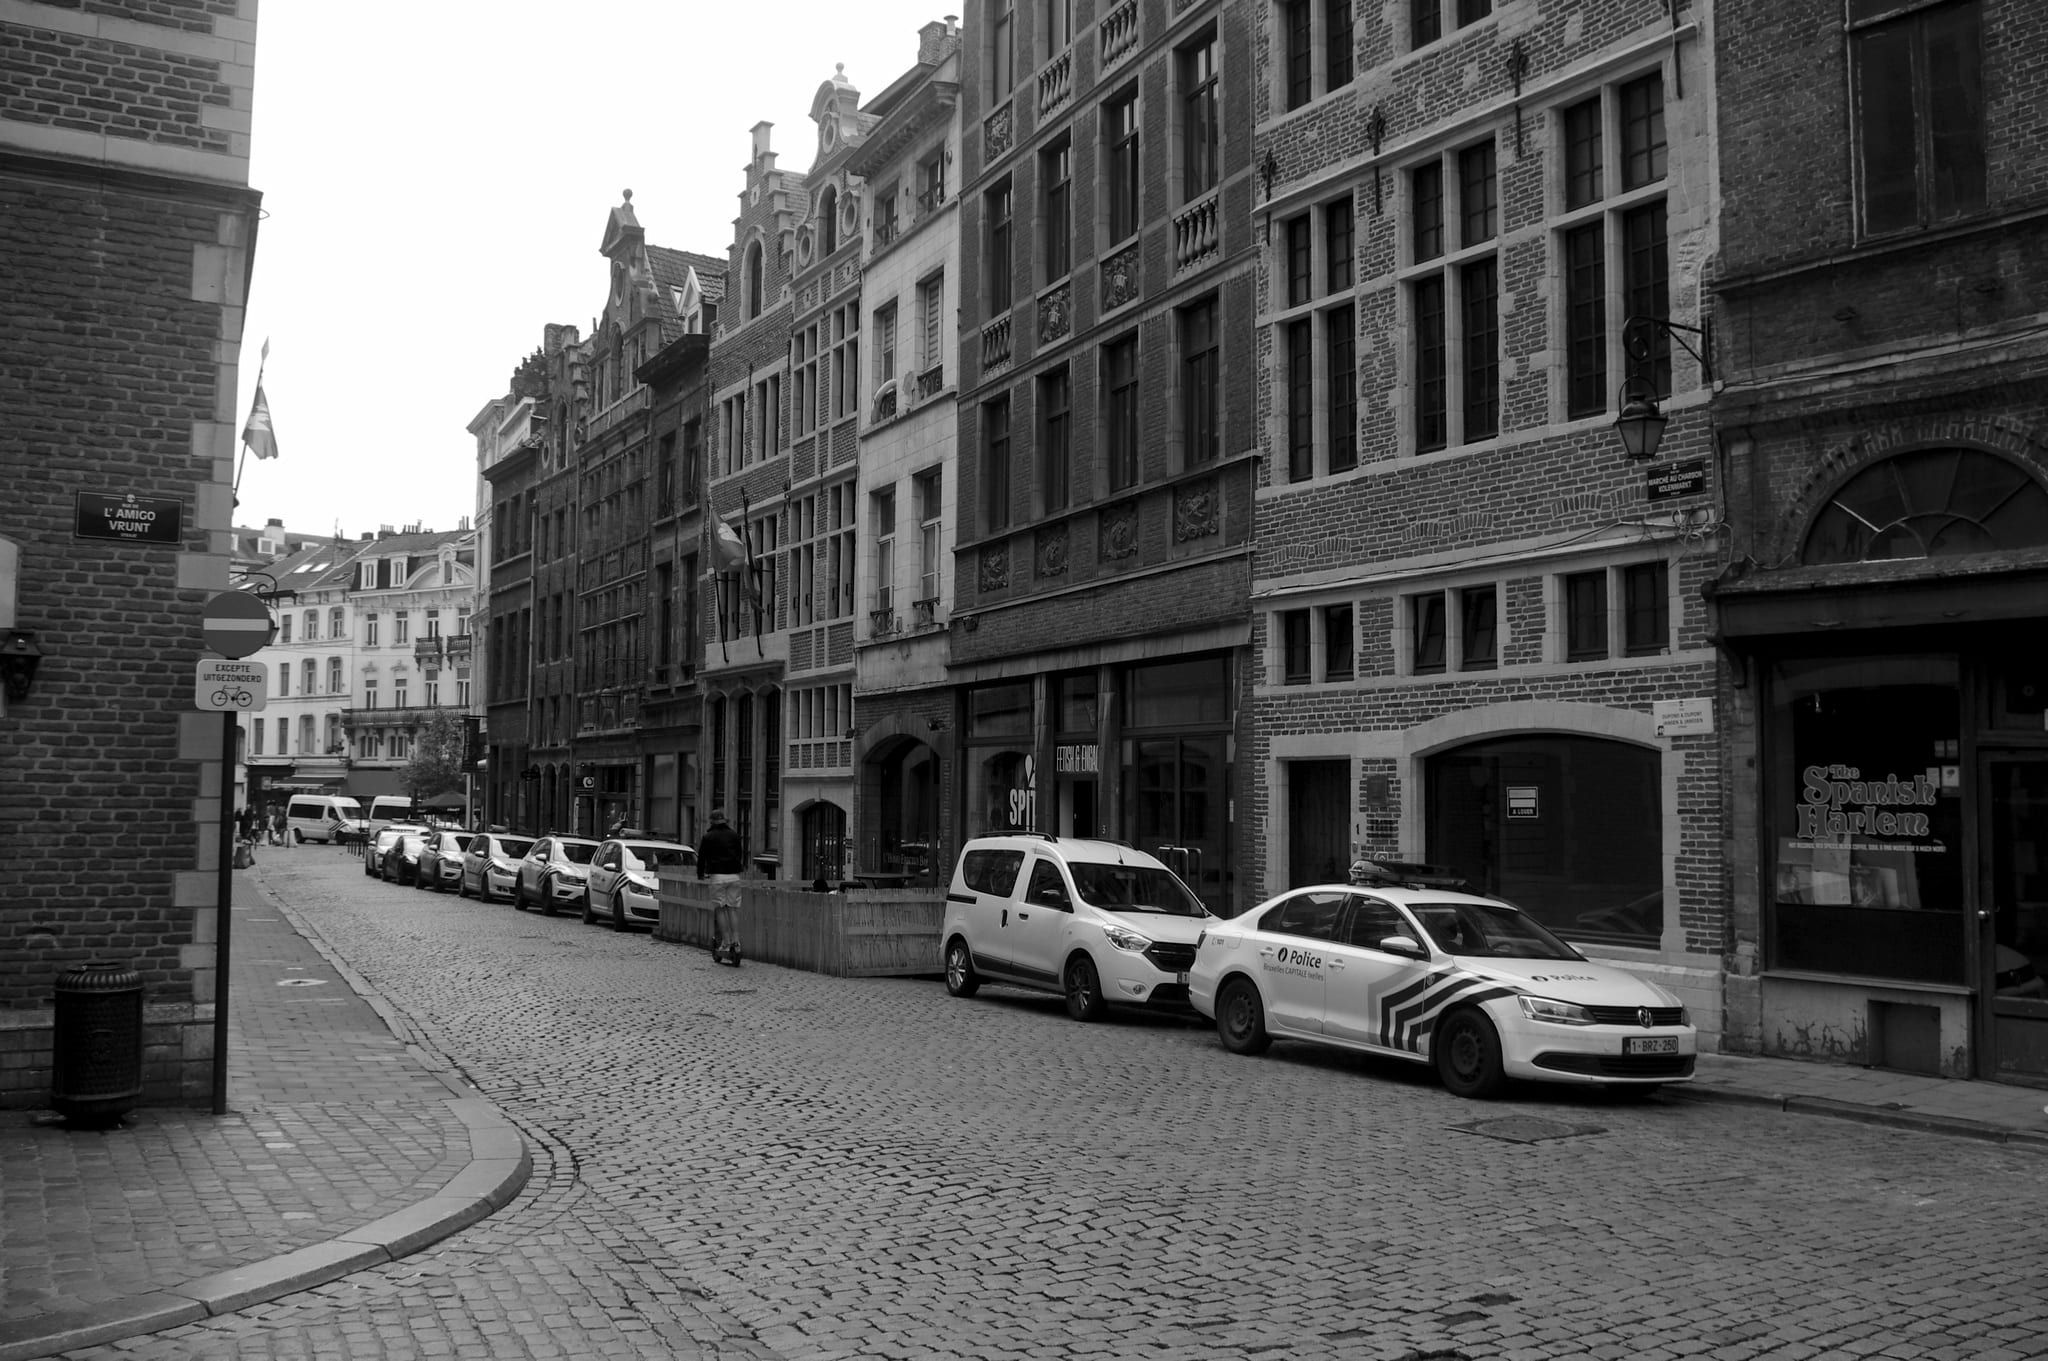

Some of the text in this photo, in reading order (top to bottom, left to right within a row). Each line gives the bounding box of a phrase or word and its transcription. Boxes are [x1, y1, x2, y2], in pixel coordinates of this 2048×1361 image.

[1649, 475, 1669, 486] MARCHÉ
[1670, 474, 1677, 482] AU
[116, 508, 156, 521] AMIGO
[109, 520, 151, 533] VRUNT
[216, 664, 250, 673] EXCEPTE
[203, 673, 262, 683] UITGEZONDERD
[1829, 764, 1860, 779] The
[1803, 765, 1937, 811] Spanish
[1796, 803, 1930, 840] Harlem
[1290, 950, 1322, 970] Police
[1263, 963, 1285, 974] Bruxelles
[1285, 967, 1307, 979] CAPITALE
[1632, 1039, 1677, 1053] 1-BRZ-250
